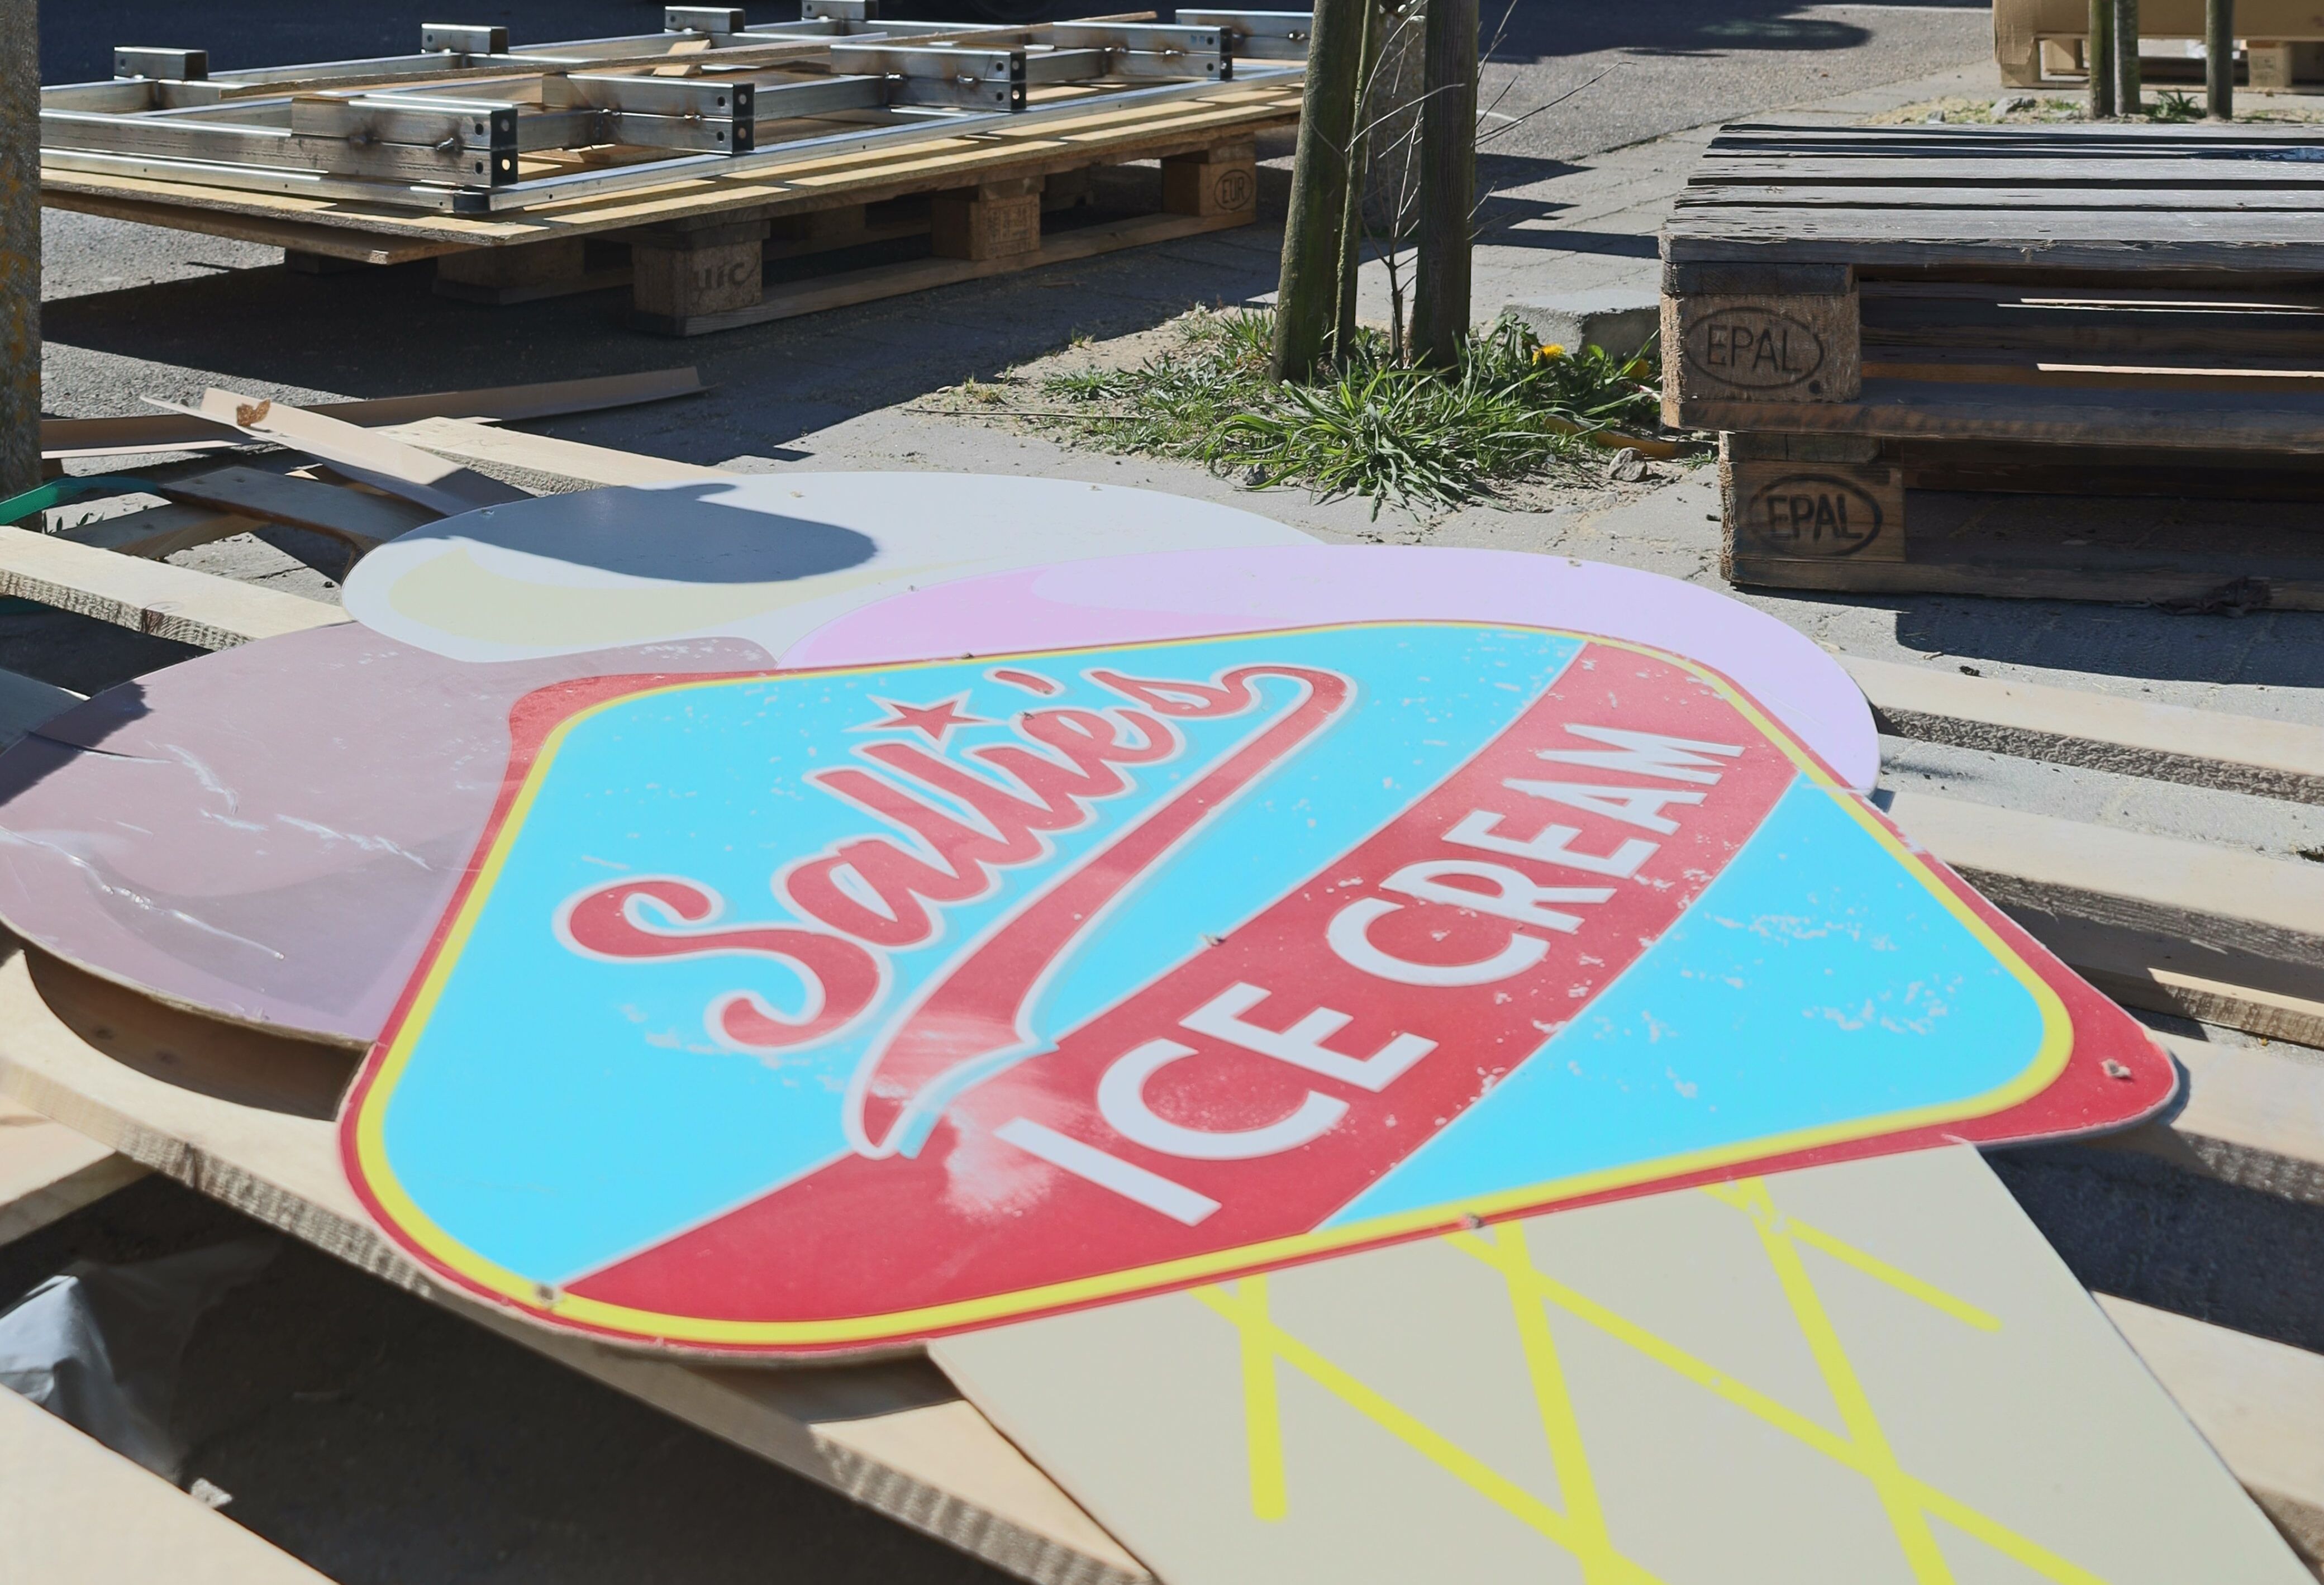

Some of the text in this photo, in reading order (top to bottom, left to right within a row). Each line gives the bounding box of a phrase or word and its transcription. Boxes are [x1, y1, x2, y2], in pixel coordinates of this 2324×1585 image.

[1222, 177, 1245, 204] EUR
[1707, 325, 1802, 373] EPAL
[1766, 493, 1863, 539] EPAL
[993, 723, 1745, 1226] ICE CREAM
